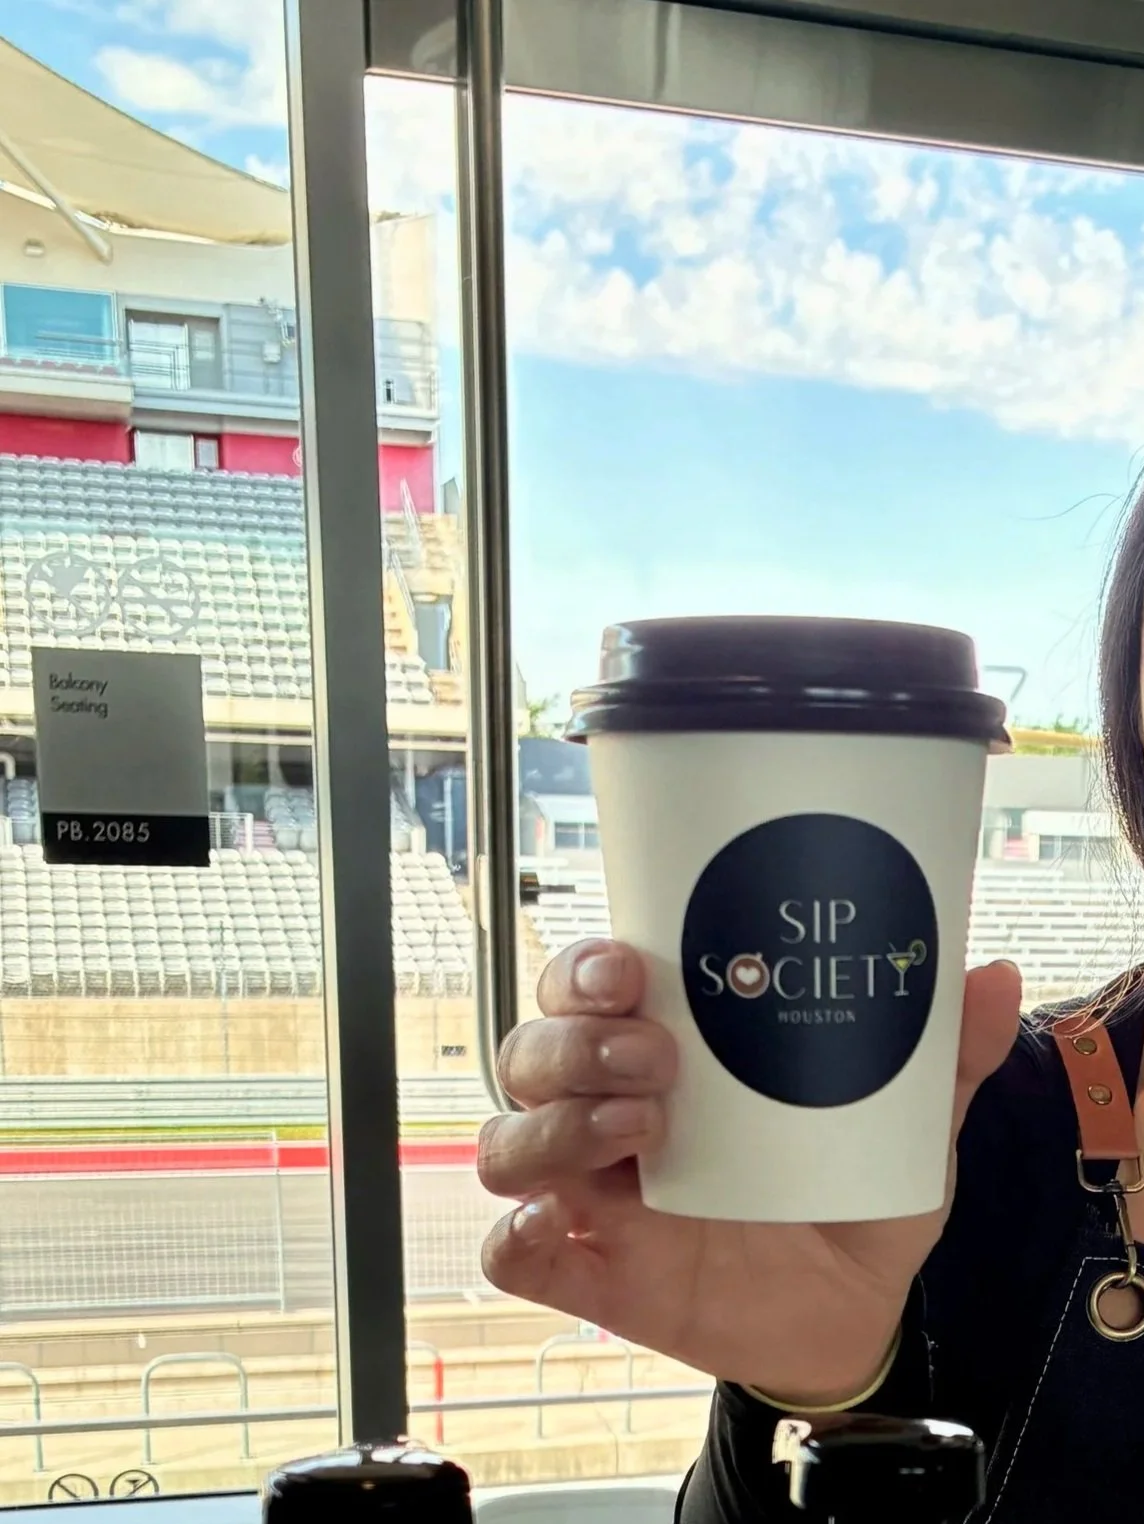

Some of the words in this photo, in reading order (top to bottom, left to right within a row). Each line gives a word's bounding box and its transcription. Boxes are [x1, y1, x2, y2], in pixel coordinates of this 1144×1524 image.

[49, 673, 108, 695] Balcony
[51, 696, 108, 718] Seating
[56, 820, 150, 843] PB.2085
[778, 899, 857, 945] SIP
[699, 951, 917, 1000] SOCIETY
[777, 1010, 857, 1024] HOUSTON
